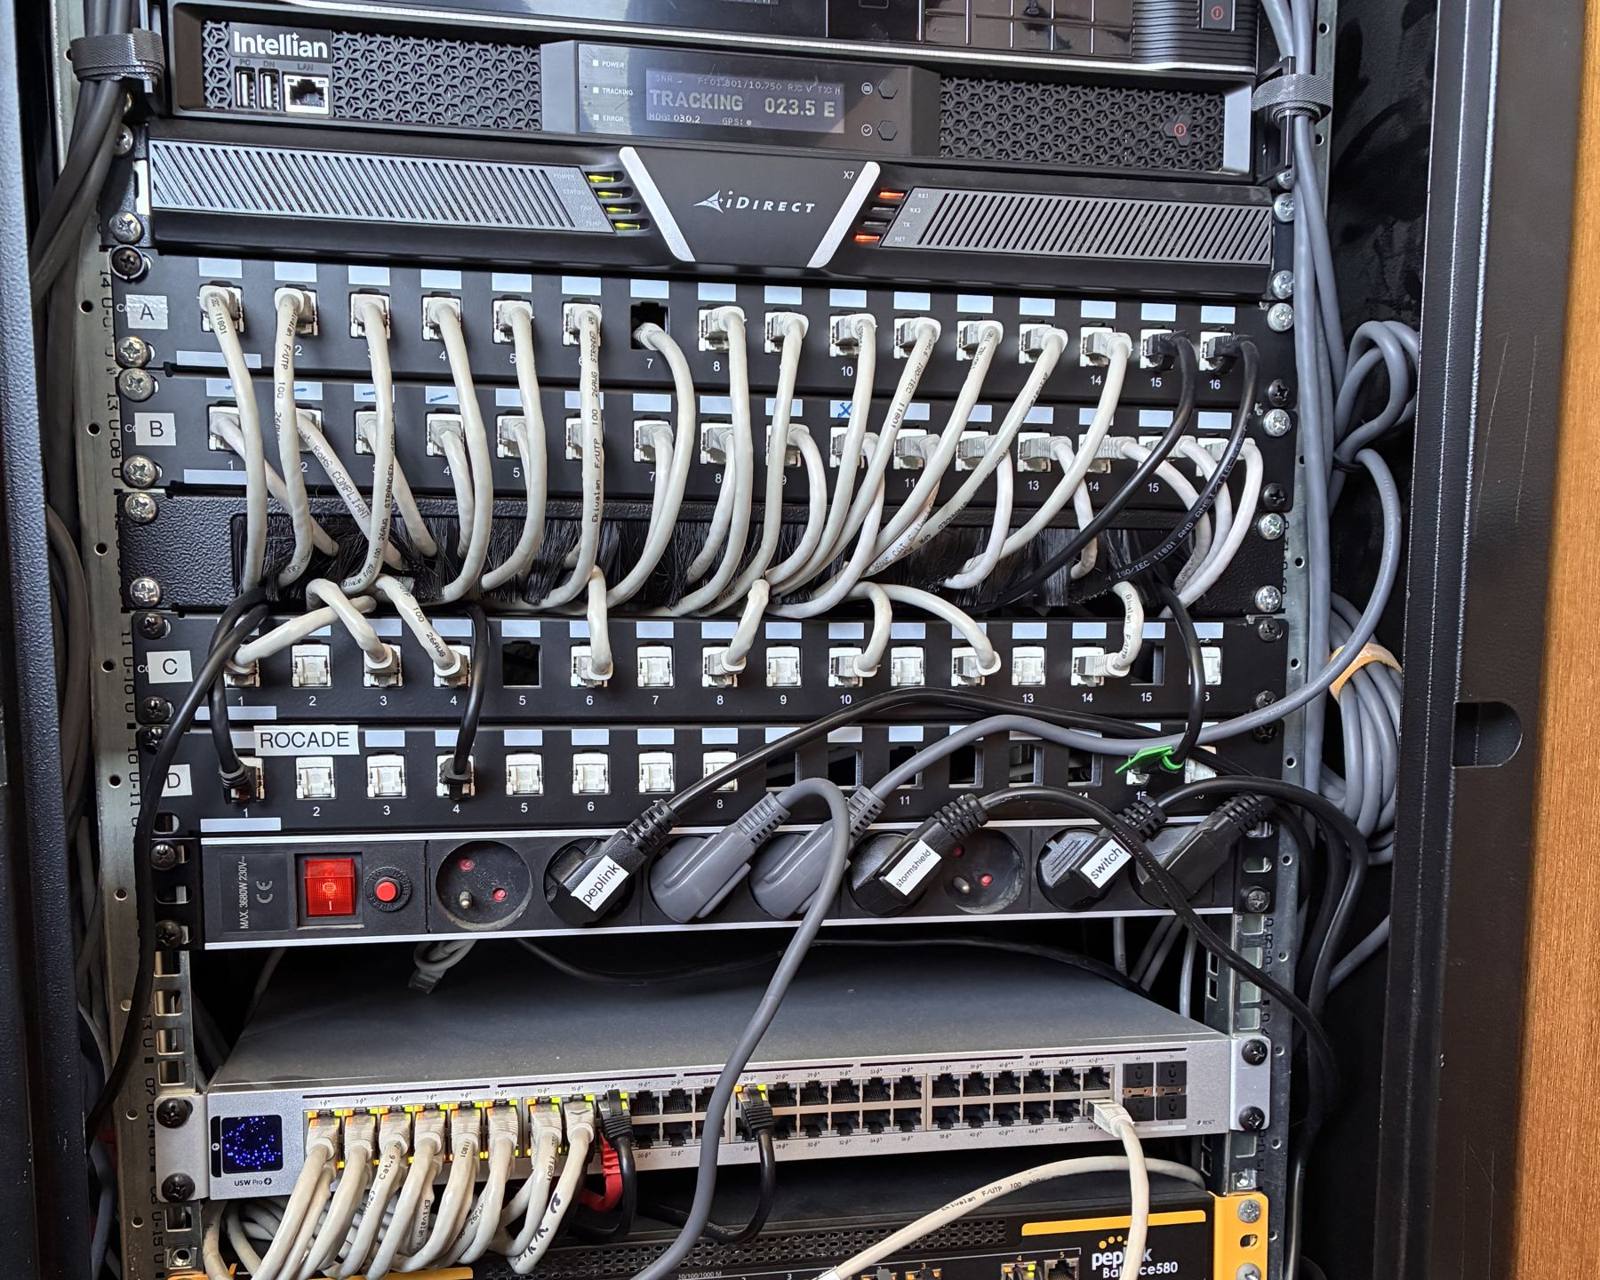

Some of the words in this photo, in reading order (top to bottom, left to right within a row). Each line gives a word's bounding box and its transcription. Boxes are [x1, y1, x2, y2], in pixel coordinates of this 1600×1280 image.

[233, 31, 328, 58] Intellian
[602, 61, 625, 69] POWER
[602, 88, 634, 96] TRACKING
[649, 89, 743, 111] TRACKING
[764, 97, 816, 116] 023.5
[823, 101, 835, 117] E
[842, 170, 855, 180] X7
[725, 190, 815, 213] iDIRECT
[140, 303, 155, 321] A
[294, 344, 302, 356] 2
[281, 343, 292, 370] F/UTP
[439, 351, 446, 361] 4
[509, 353, 516, 364] 5
[646, 358, 653, 369] 7
[713, 361, 721, 372] 8
[841, 366, 853, 377] 10
[1090, 375, 1102, 386] 14
[1150, 377, 1162, 388] 15
[1209, 379, 1221, 390] 16
[150, 420, 164, 437] B
[301, 462, 308, 473] 2
[443, 466, 450, 476] 4
[512, 467, 520, 478] 5
[313, 444, 331, 469] RoHS
[331, 470, 371, 521] COMPLIANT
[649, 472, 655, 482] 7
[714, 473, 722, 484] 8
[904, 478, 915, 488] 11
[1027, 480, 1039, 491] 13
[1087, 481, 1100, 492] 14
[1147, 482, 1159, 493] 15
[1153, 540, 1177, 562] 11801
[1177, 521, 1194, 540] AND
[412, 606, 426, 623] 100
[162, 658, 178, 676] C
[238, 696, 244, 706] 1
[309, 695, 317, 706] 2
[380, 695, 387, 706] 3
[450, 695, 458, 706] 4
[519, 695, 526, 706] 5
[586, 695, 593, 706] 6
[652, 695, 659, 706] 7
[716, 695, 724, 705] 8
[780, 694, 787, 705] 9
[840, 694, 852, 705] 10
[1022, 693, 1034, 704] 13
[1081, 692, 1093, 703] 14
[1141, 692, 1152, 703] 15
[259, 731, 350, 748] ROCADE
[166, 772, 181, 789] D
[716, 799, 724, 809] 8
[899, 796, 910, 806] 11
[312, 806, 320, 817] 2
[383, 805, 391, 815] 3
[453, 804, 460, 814] 4
[520, 803, 528, 813] 5
[587, 802, 595, 812] 6
[243, 808, 249, 818] 1
[895, 849, 932, 889] stormshield
[1090, 847, 1123, 880] switch
[582, 863, 621, 905] peplink
[239, 880, 249, 907] 3680W
[239, 908, 249, 930] MAX.
[234, 1179, 251, 1187] USW
[981, 1186, 1003, 1197] F/UTP
[1060, 1251, 1065, 1259] 5
[1102, 1261, 1179, 1279] Balce580
